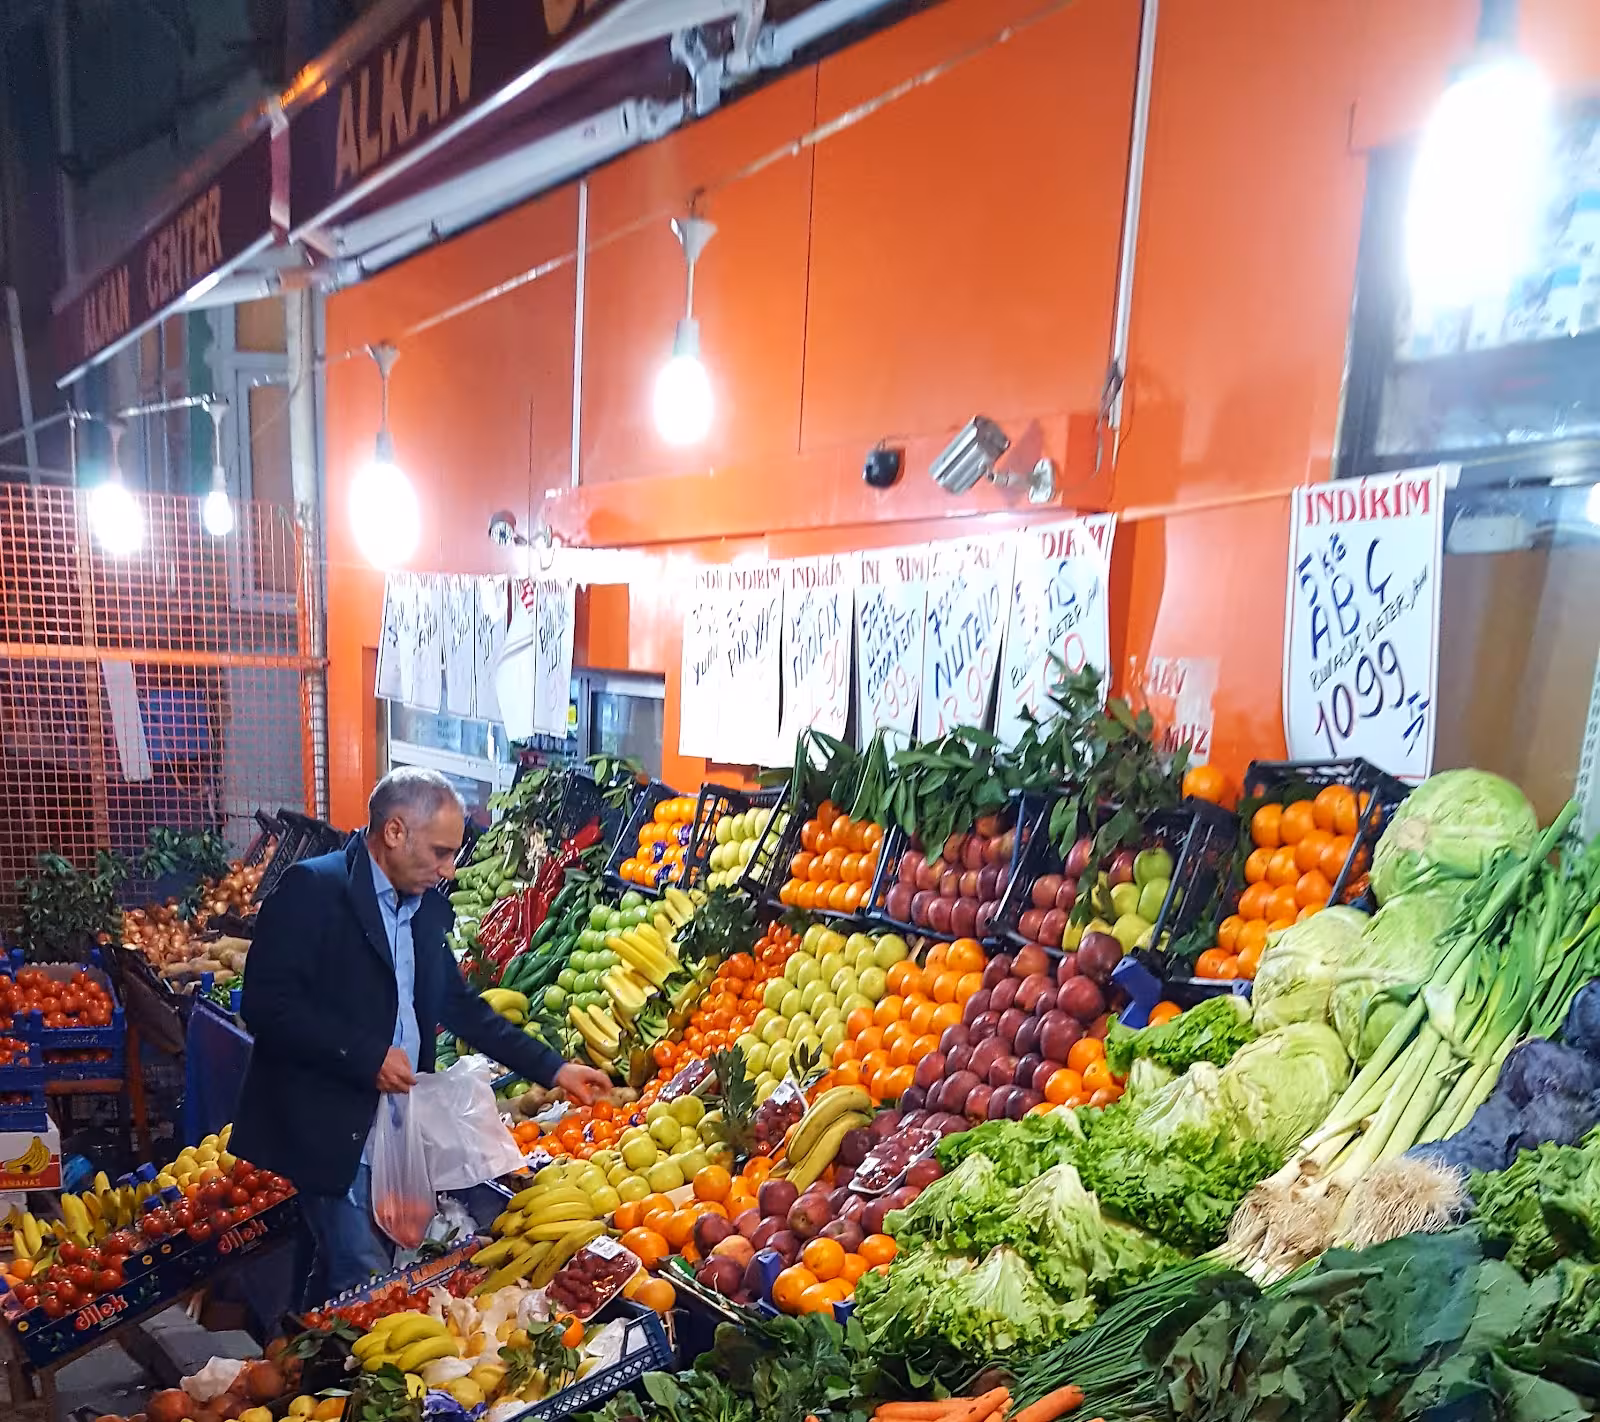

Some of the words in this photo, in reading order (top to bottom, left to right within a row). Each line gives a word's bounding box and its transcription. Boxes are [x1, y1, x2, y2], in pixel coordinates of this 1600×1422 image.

[335, 0, 473, 192] ALKAN
[84, 264, 130, 356] ALKAN
[146, 184, 223, 309] CENTER
[1164, 723, 1210, 755] MUZ
[74, 1293, 129, 1331] dilek
